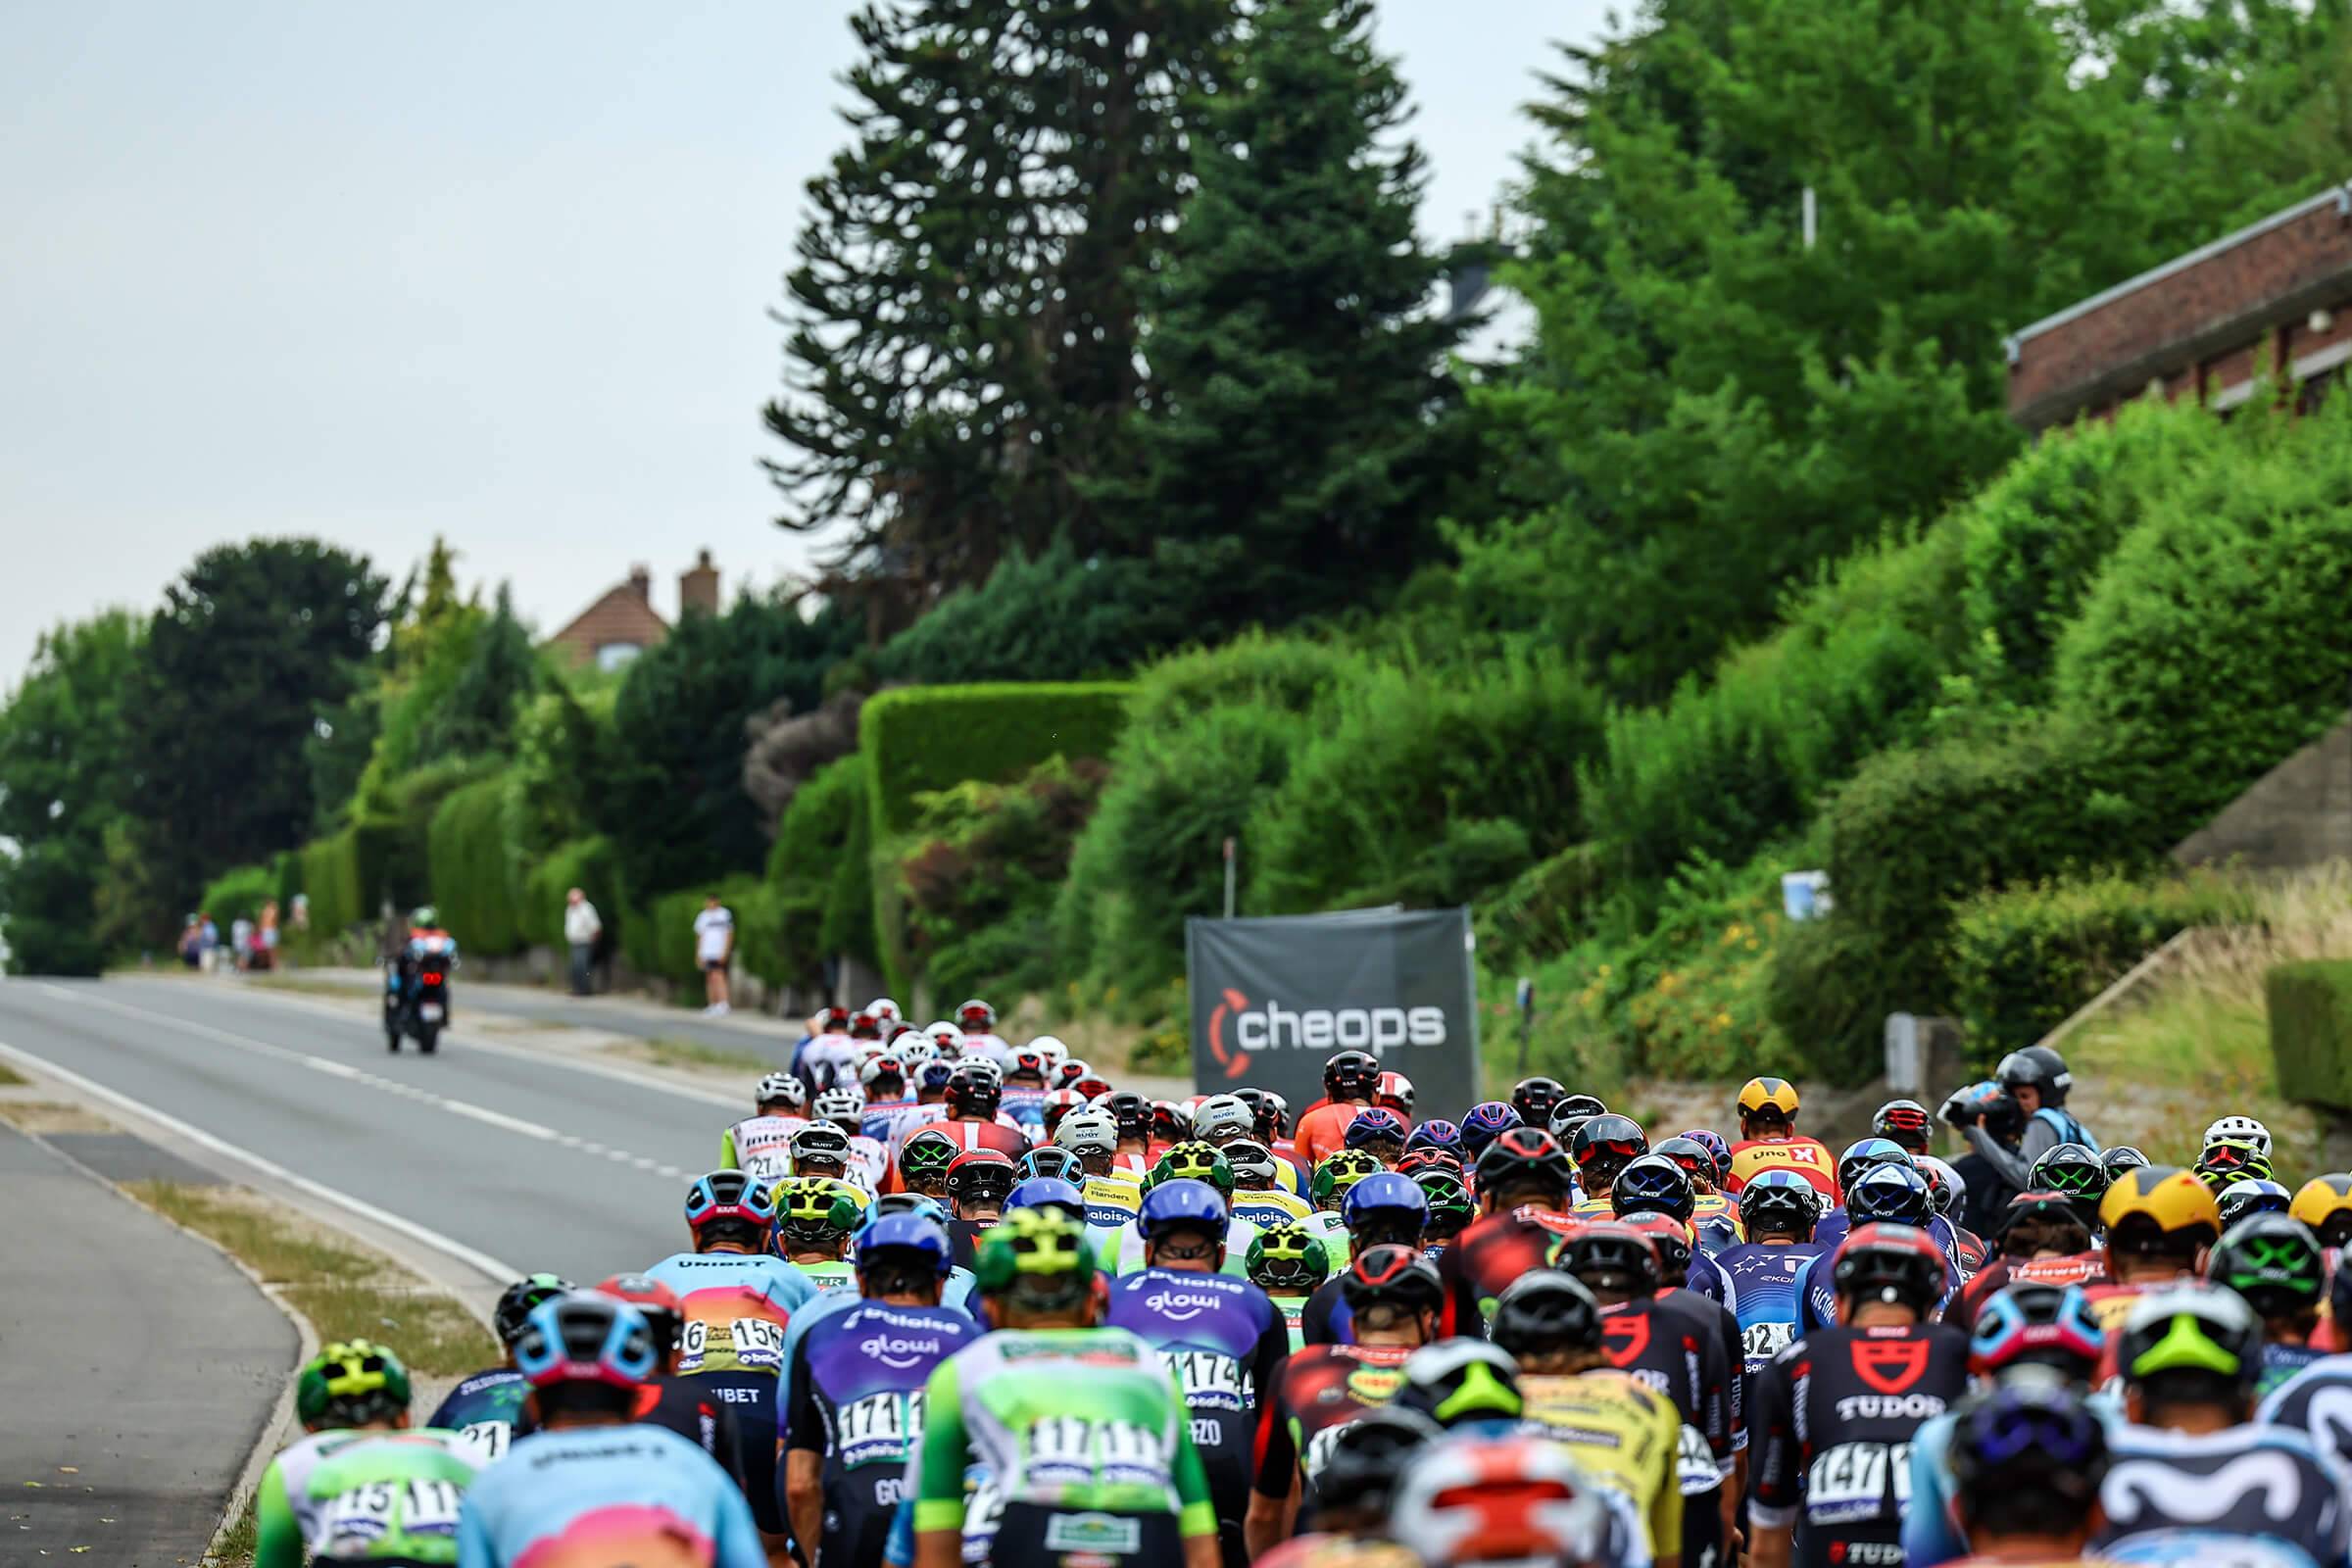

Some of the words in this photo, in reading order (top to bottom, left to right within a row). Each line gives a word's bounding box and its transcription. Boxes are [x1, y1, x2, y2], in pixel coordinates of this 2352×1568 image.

[1237, 999, 1446, 1058] cheops
[1752, 1151, 1787, 1160] Uno
[1091, 1191, 1130, 1202] Flanders
[1145, 1290, 1222, 1312] glowi
[860, 1333, 941, 1359] glowi
[1811, 1443, 1882, 1494] 147
